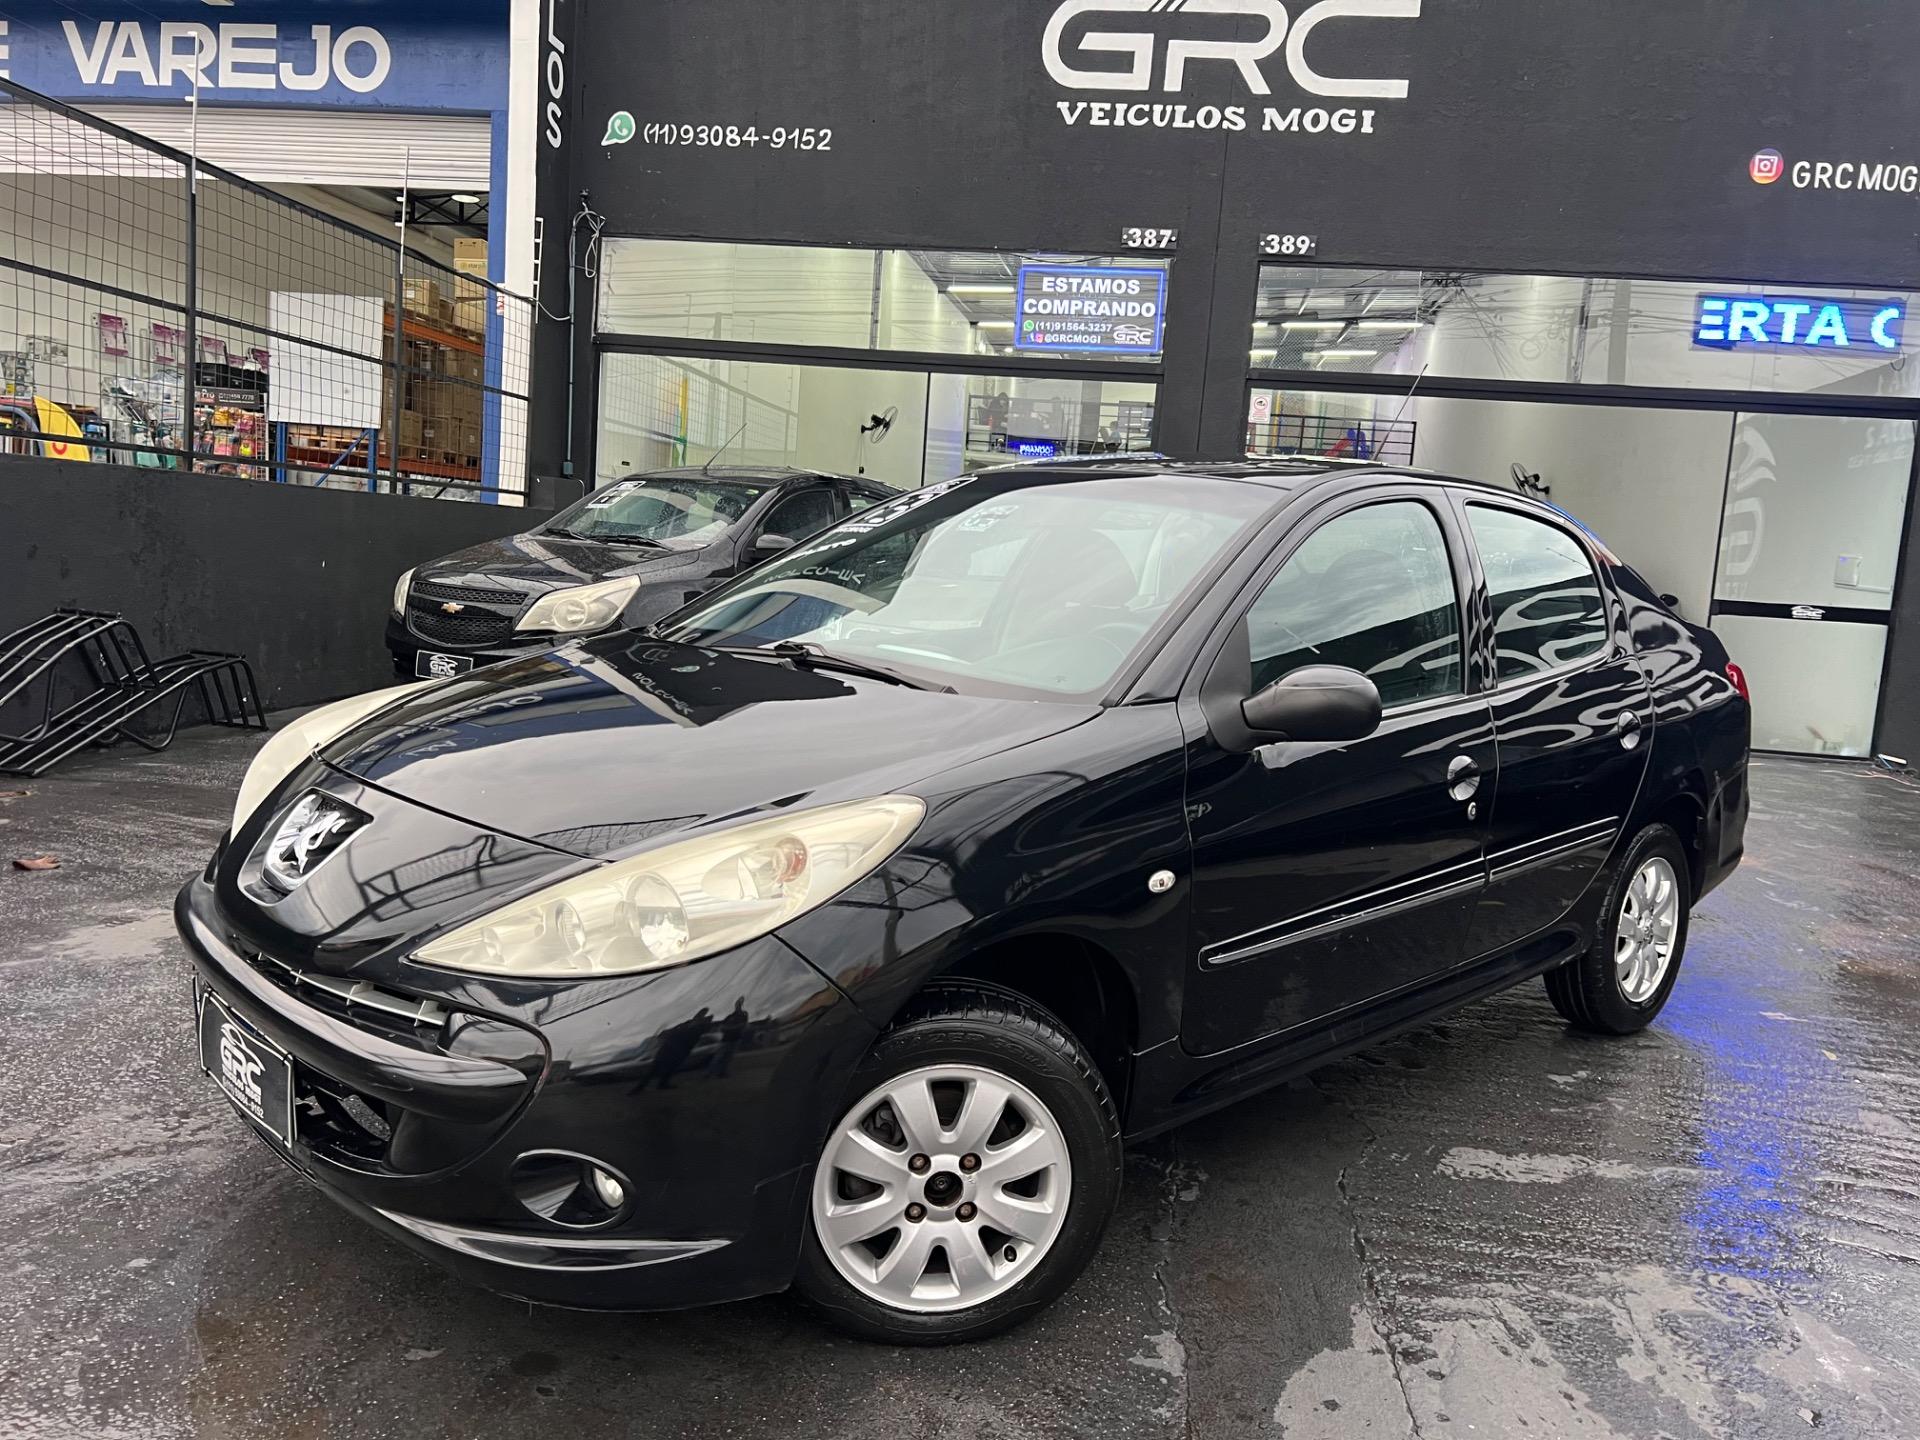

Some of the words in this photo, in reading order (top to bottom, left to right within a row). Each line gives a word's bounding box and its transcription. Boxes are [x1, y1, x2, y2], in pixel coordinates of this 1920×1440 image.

[60, 20, 391, 93] VAREJO
[1041, 0, 1421, 98] GRC
[1056, 101, 1247, 131] VEICULOS
[1262, 107, 1375, 133] MOGI
[643, 123, 832, 151] (11)93084-9152
[1792, 160, 1920, 193] GRCMOG
[1127, 228, 1172, 248] 387
[1265, 234, 1310, 255] 389
[1042, 277, 1141, 295] ESTAMOS
[1024, 298, 1156, 317] COMPRANDO
[1113, 331, 1151, 342] GRC
[430, 660, 456, 674] GRC
[221, 1037, 262, 1095] GRC
